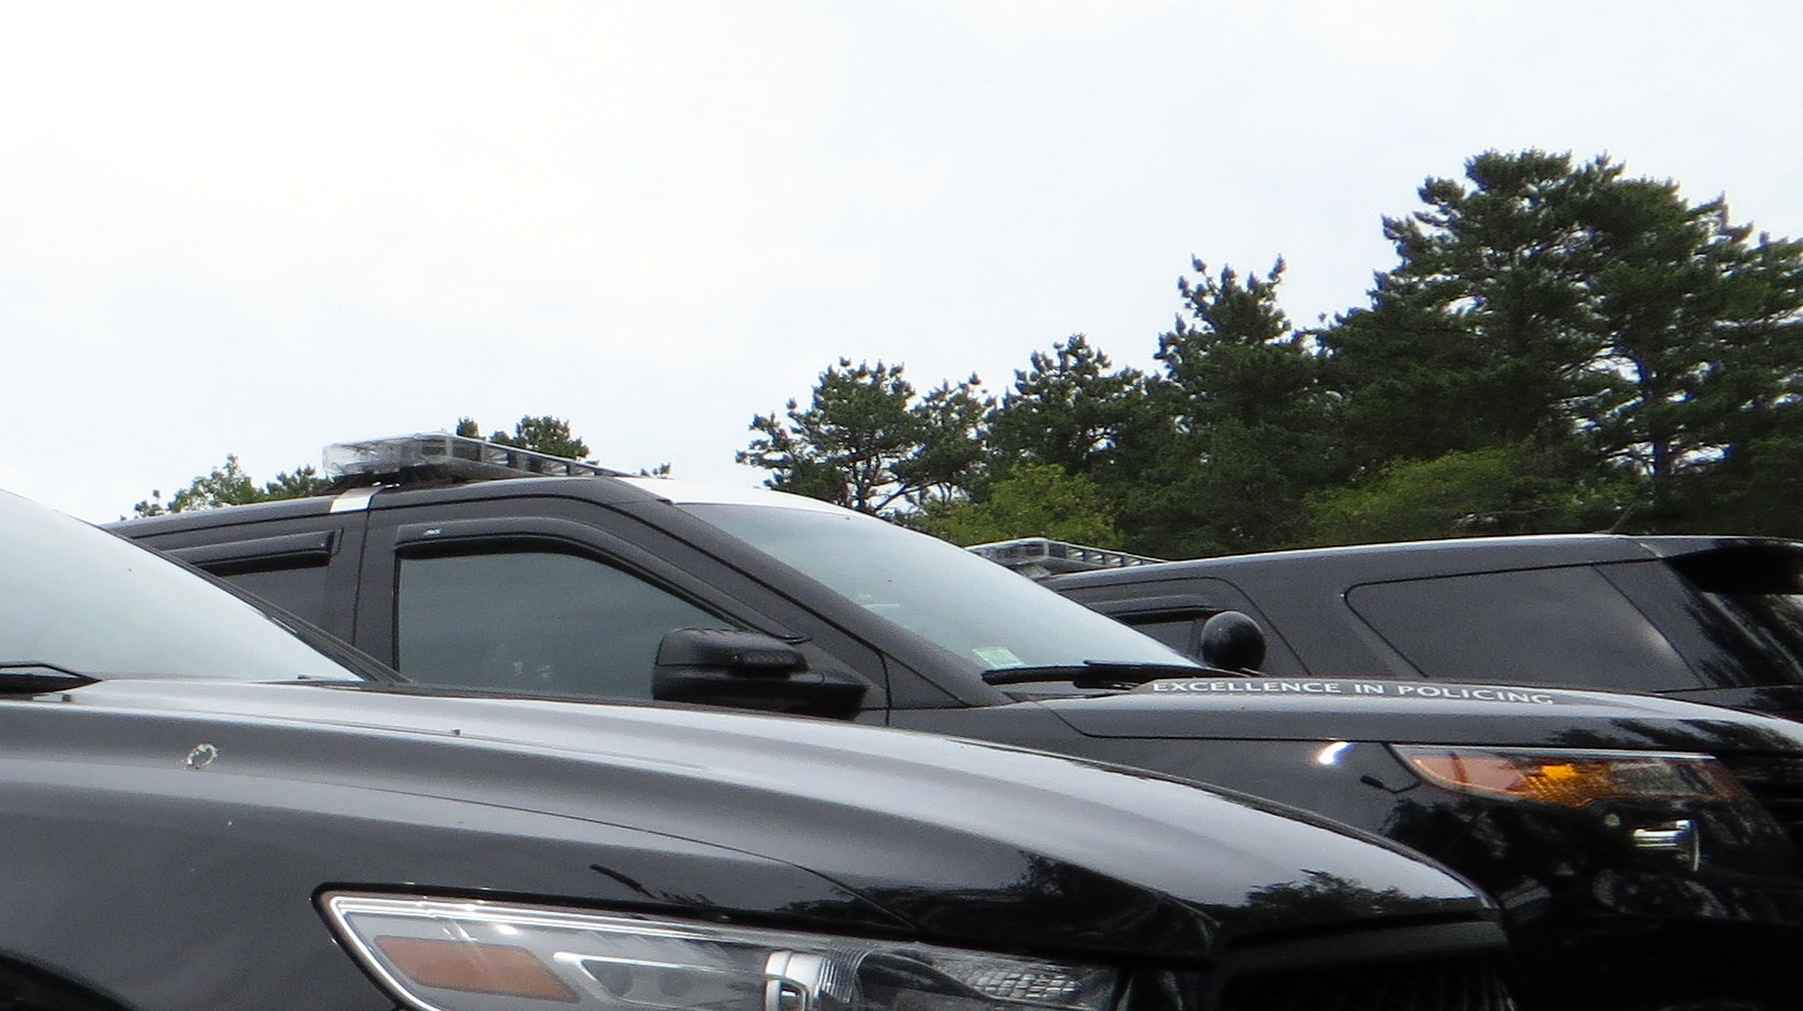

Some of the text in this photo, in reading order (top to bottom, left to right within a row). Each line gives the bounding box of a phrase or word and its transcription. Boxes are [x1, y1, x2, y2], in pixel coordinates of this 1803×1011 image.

[1153, 681, 1553, 705] EXCELLENCE IN POLICING
